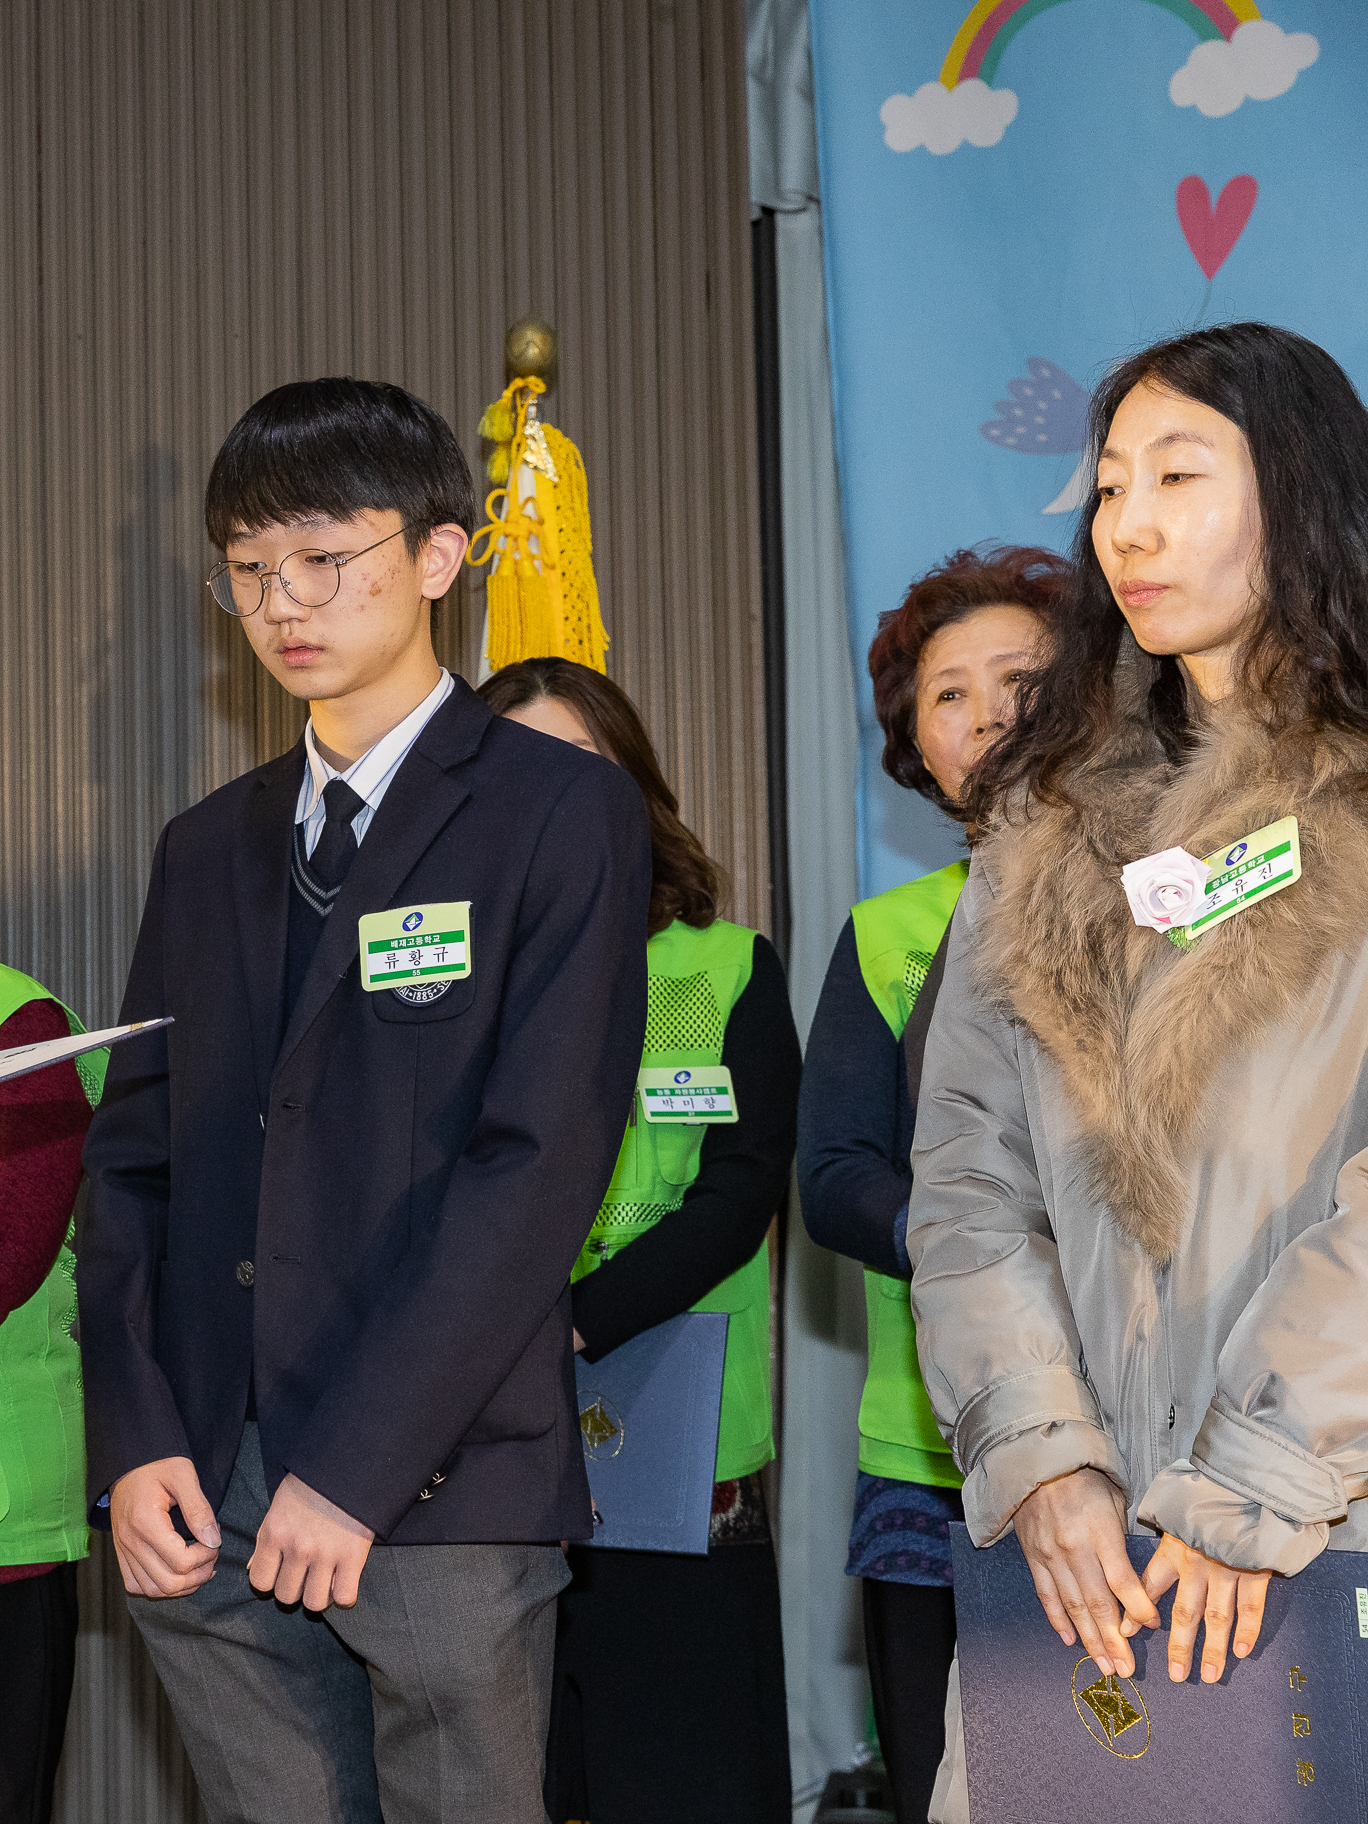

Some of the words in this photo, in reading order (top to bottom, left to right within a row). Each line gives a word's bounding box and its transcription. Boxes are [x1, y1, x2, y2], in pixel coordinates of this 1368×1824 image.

[390, 934, 441, 949] 배재고등학교
[412, 969, 421, 977] 55
[412, 989, 434, 1001] 1885
